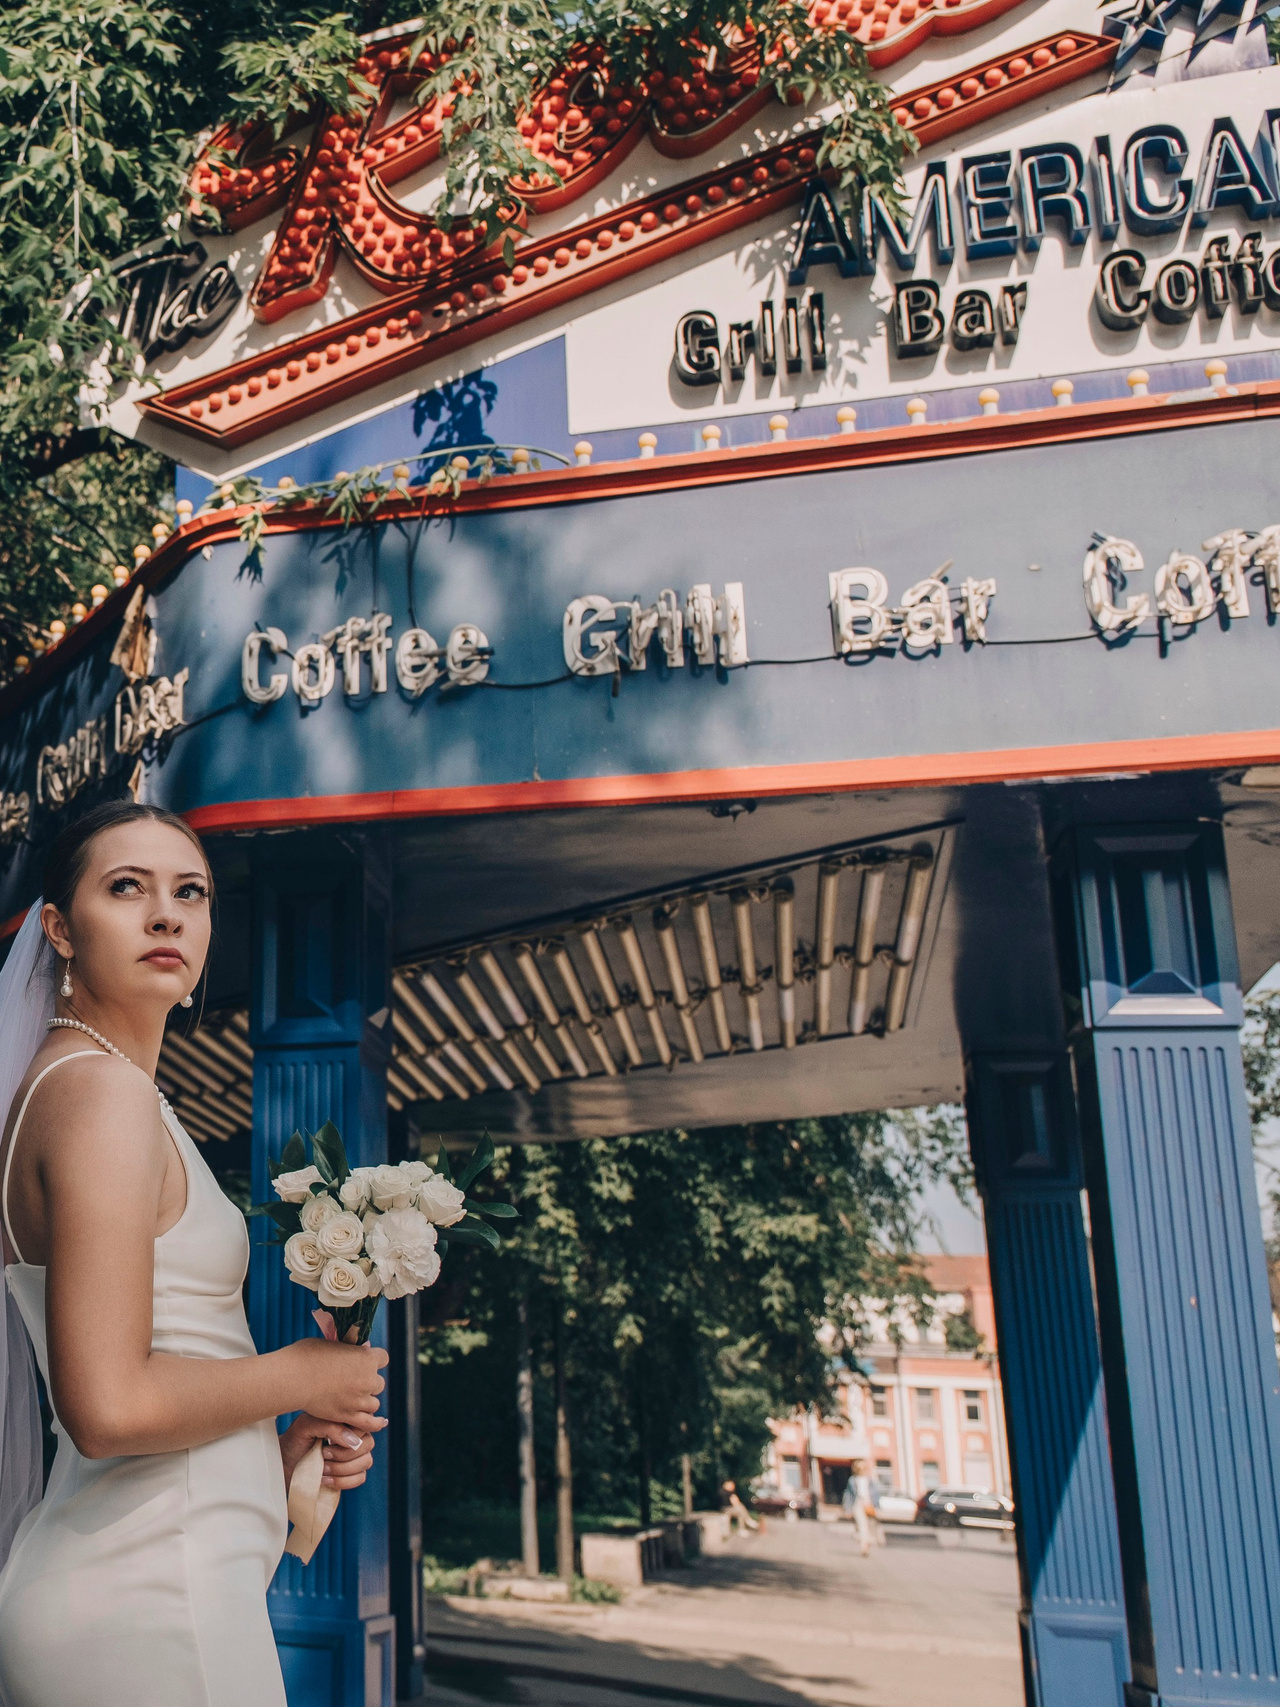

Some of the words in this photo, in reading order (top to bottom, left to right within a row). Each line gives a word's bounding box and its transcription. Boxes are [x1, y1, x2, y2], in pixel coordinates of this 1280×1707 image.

[787, 108, 1280, 286] AMERICA
[674, 293, 826, 387] Grill
[893, 278, 1028, 360] Bar
[241, 611, 491, 706] Coffee
[562, 581, 749, 677] Grill
[828, 565, 997, 654] Bar
